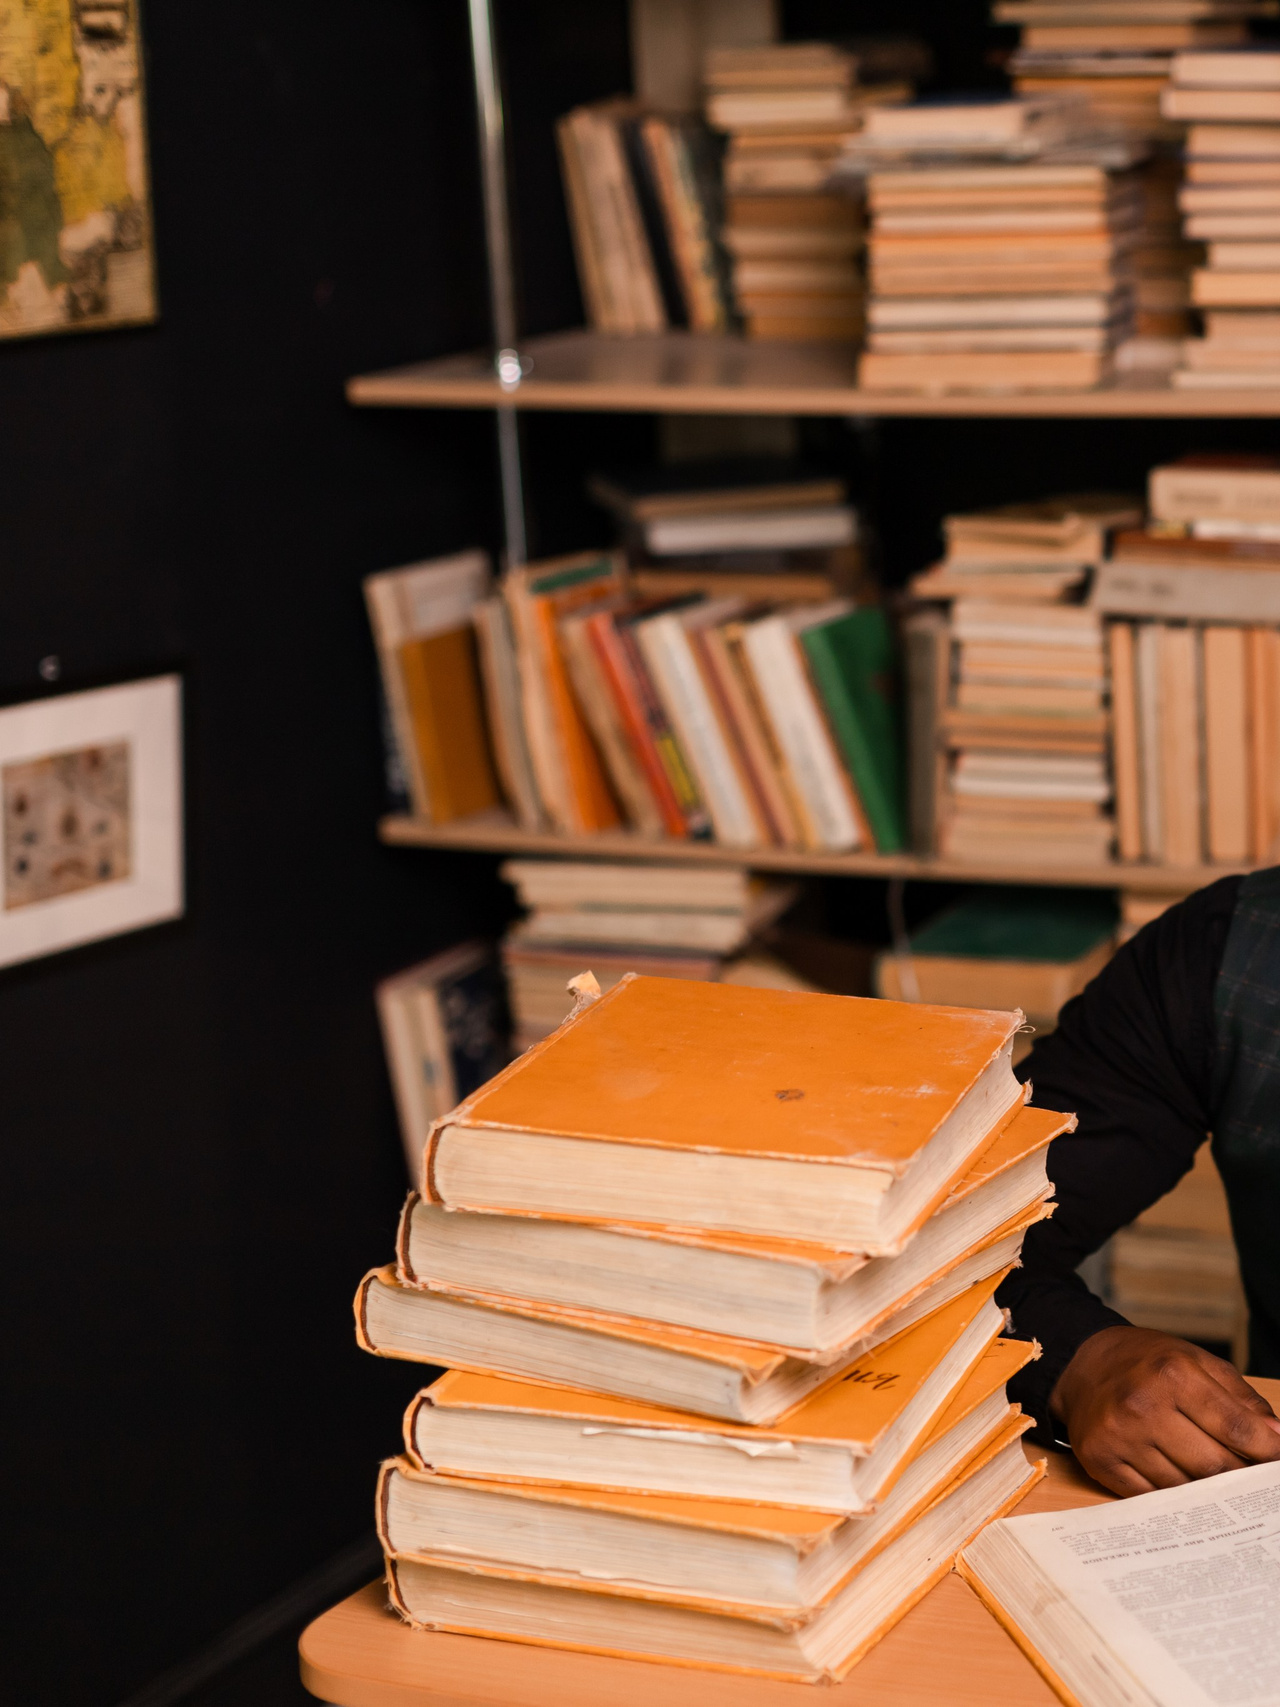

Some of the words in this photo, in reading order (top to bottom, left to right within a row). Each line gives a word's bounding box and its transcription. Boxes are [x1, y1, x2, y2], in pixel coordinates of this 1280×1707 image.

[1208, 1523, 1265, 1541] ЖИВОТНЫЙ
[1184, 1539, 1204, 1547] МИР
[1145, 1544, 1179, 1554] МОРЕЙ
[1082, 1553, 1129, 1565] ОКЕАНОВ
